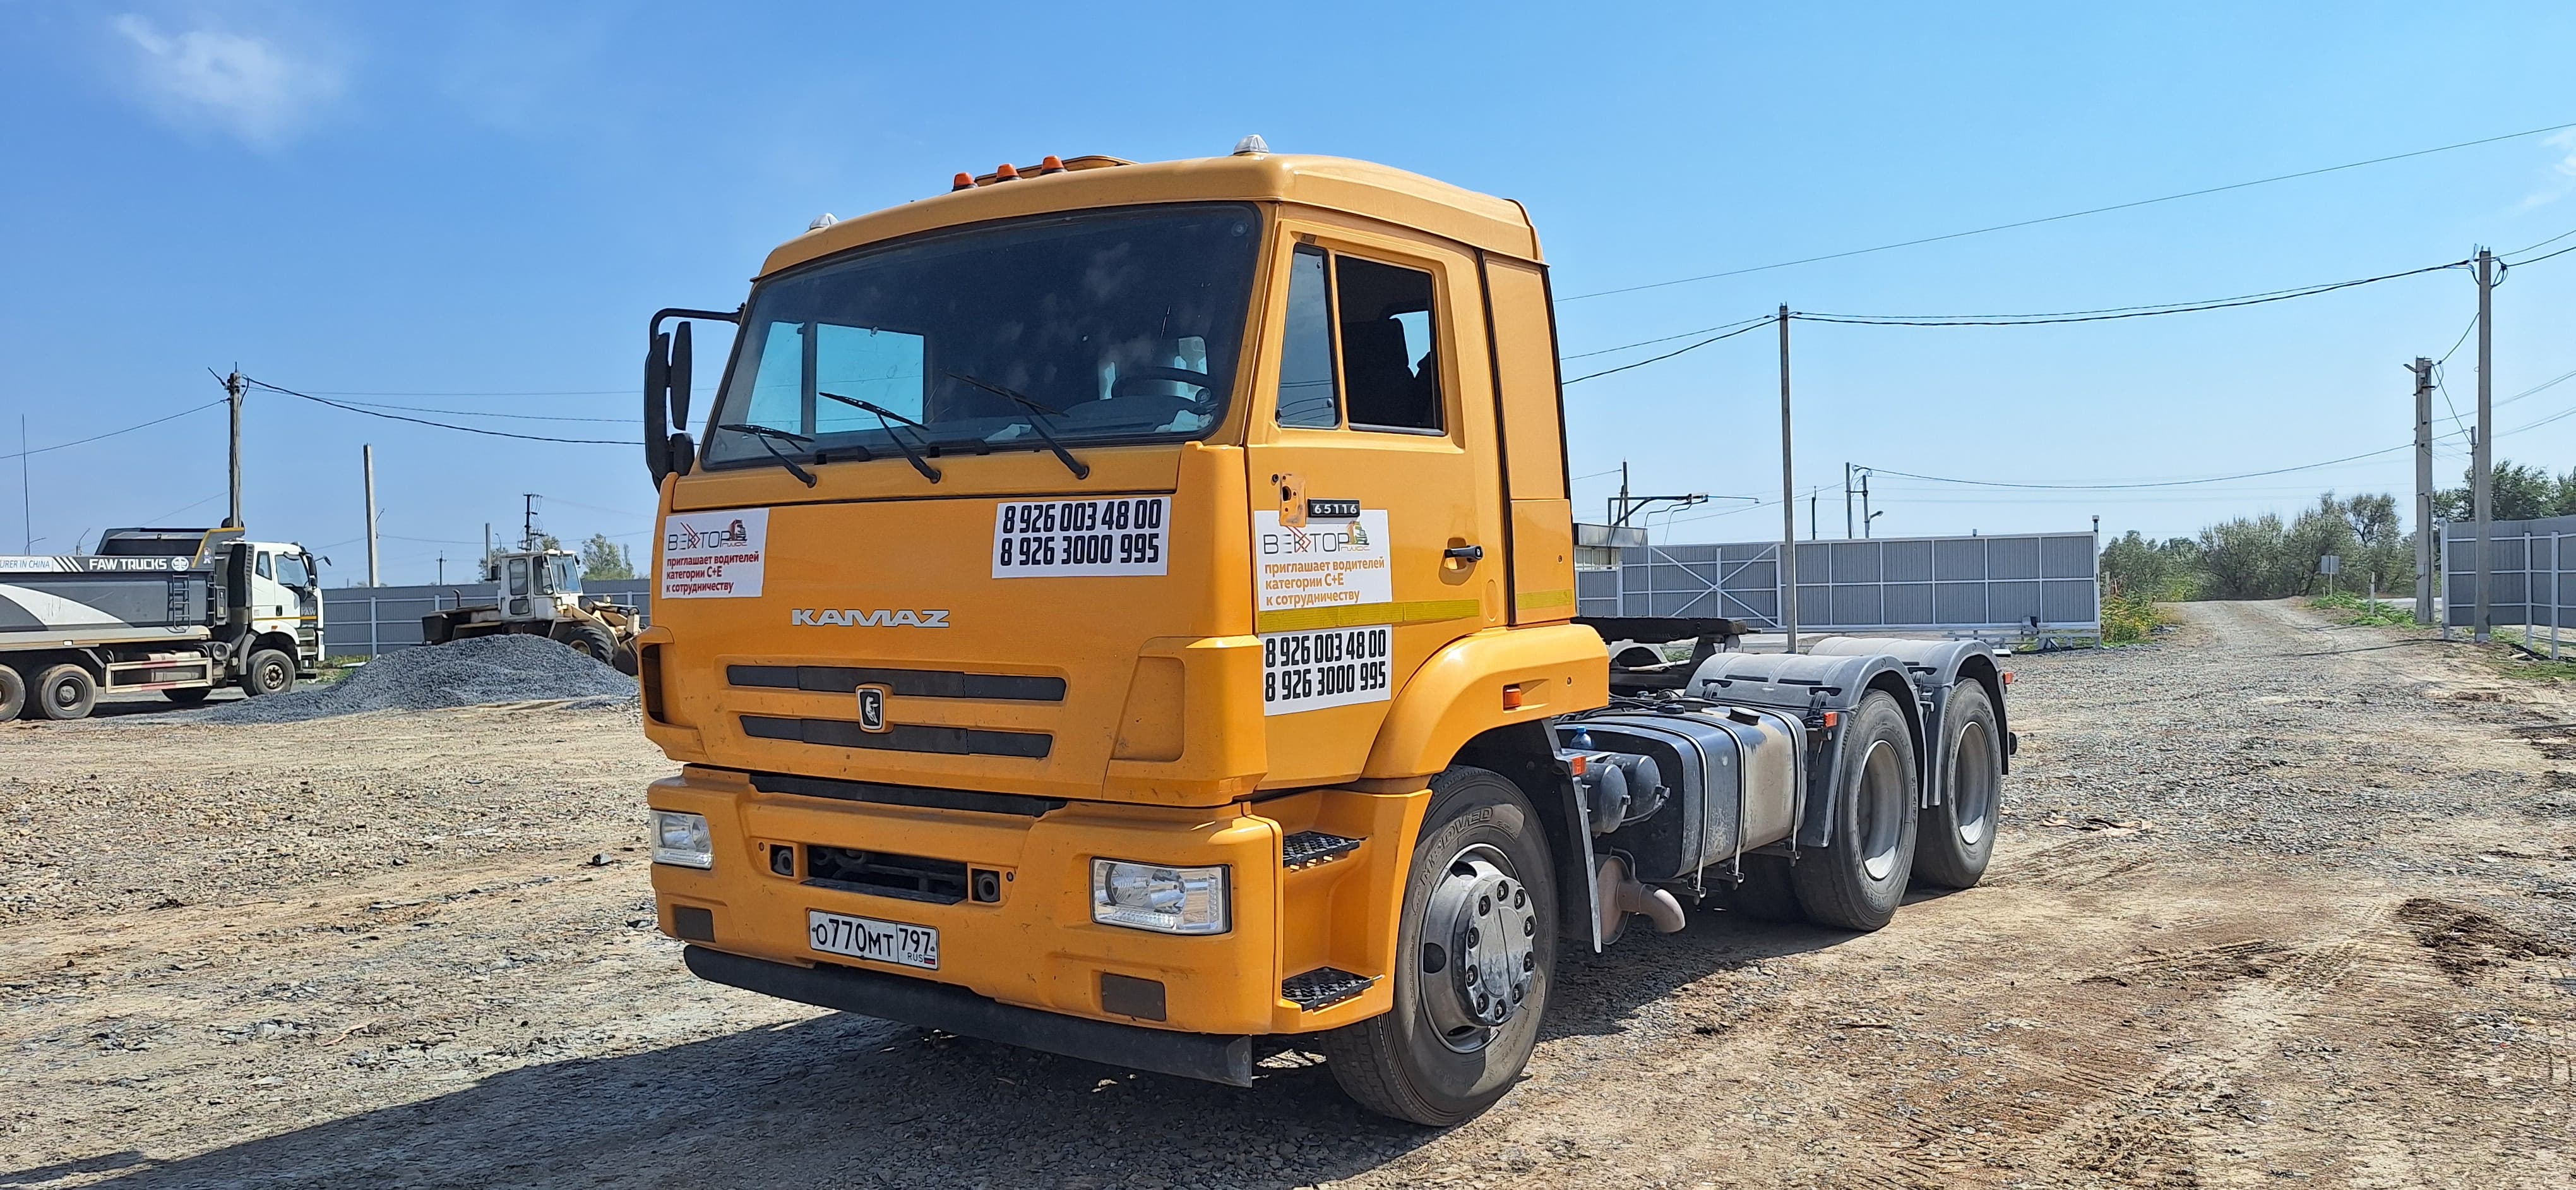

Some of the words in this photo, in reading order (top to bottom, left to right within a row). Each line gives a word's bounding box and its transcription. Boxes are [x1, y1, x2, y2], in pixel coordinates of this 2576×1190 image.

[1003, 505, 1016, 534] 8
[1020, 504, 1056, 533] 926
[1059, 502, 1097, 531] 003
[1101, 500, 1130, 530] 48
[1134, 499, 1162, 529] 00
[1314, 505, 1357, 514] 65116
[1000, 538, 1013, 566] 8
[1019, 536, 1055, 565] 926
[1061, 534, 1113, 565] 3000
[1120, 533, 1159, 563] 995
[28, 560, 50, 568] CHINA
[89, 559, 117, 570] FAW
[121, 559, 167, 570] TRUCKS
[667, 556, 713, 569] приглашает
[714, 551, 760, 565] водителей
[1265, 562, 1330, 577] приглашает
[1333, 556, 1385, 572] водителей
[666, 570, 705, 582] категории
[1265, 577, 1323, 592] категории
[672, 582, 734, 596] сотрудничеству
[1266, 596, 1273, 606] к
[1275, 591, 1360, 608] сотрудничеству
[301, 606, 316, 616] FAW
[792, 608, 950, 628] KAMAZ
[1265, 638, 1276, 668] 8
[1280, 636, 1310, 667] 926
[1315, 633, 1342, 663] 003
[1345, 632, 1365, 660] 48
[1369, 629, 1386, 658] 00
[1265, 672, 1275, 702] 8
[1282, 668, 1312, 700] 926
[1317, 664, 1355, 696] 3000
[1360, 661, 1386, 691] 995
[899, 928, 931, 954] 797
[907, 953, 923, 962] RUS
